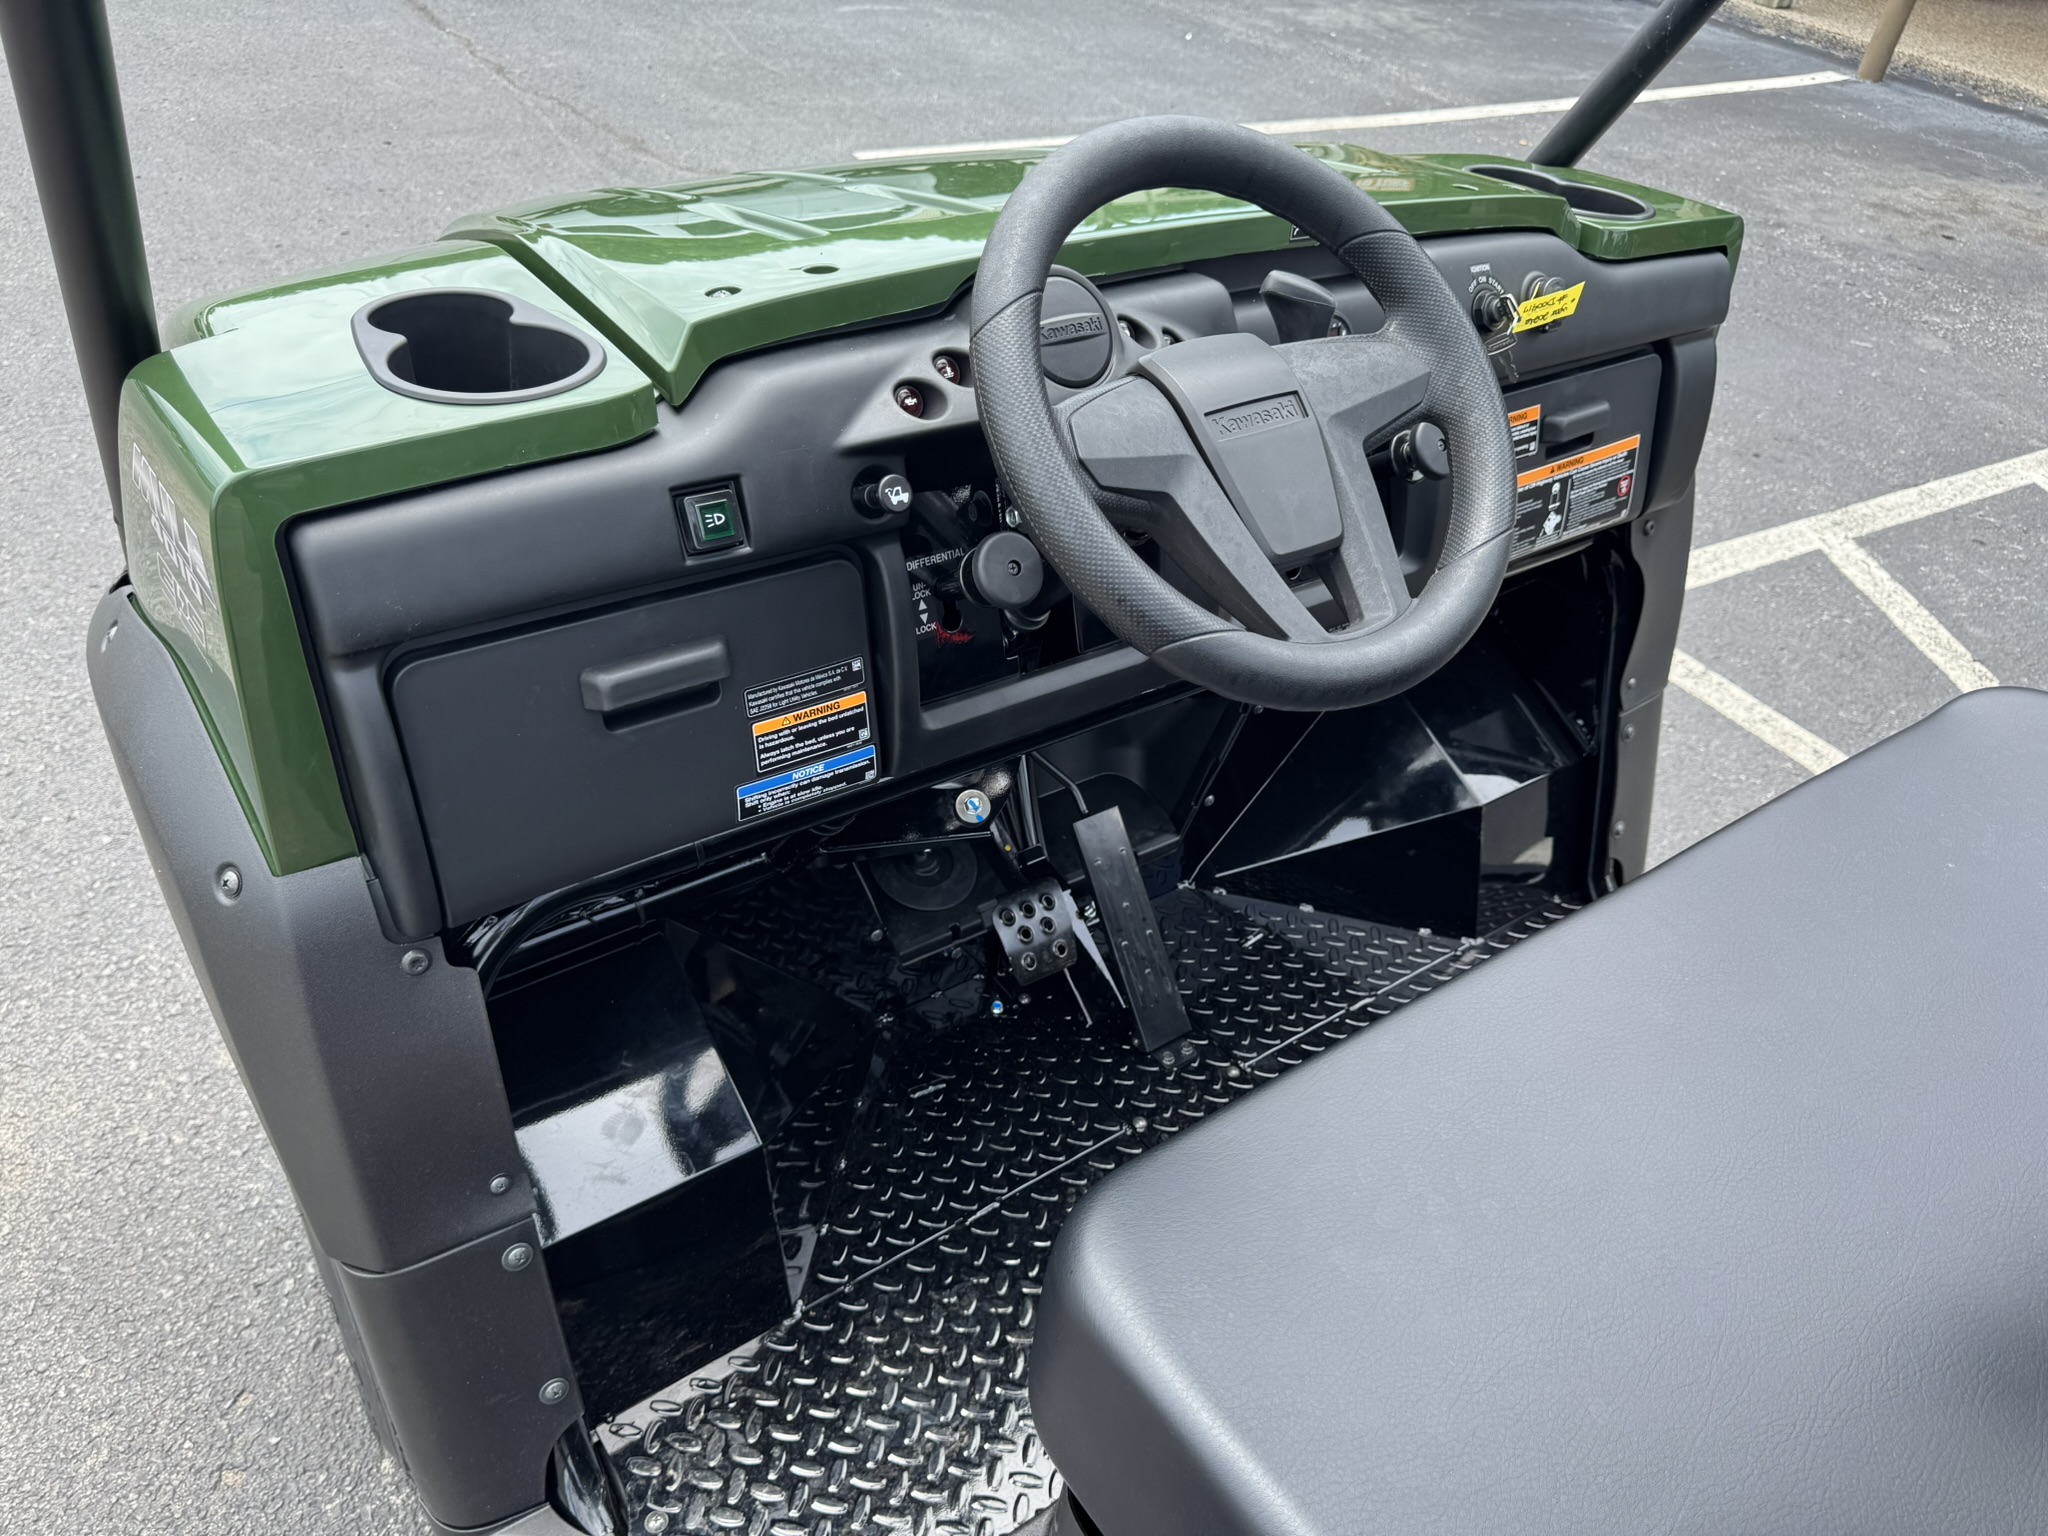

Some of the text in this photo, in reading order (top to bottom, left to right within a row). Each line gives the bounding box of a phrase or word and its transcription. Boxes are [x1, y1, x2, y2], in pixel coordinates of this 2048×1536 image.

[1470, 262, 1490, 273] IGNITION
[1468, 275, 1505, 295] OFF ON START
[1211, 399, 1299, 436] Kawasaki
[1556, 456, 1584, 472] WARNING
[906, 547, 964, 572] DIFFERENTIAL
[915, 621, 937, 635] LOCK
[747, 688, 773, 700] Manufactured
[778, 682, 795, 691] Kawasaki
[749, 697, 768, 708] Kawasaki
[785, 689, 793, 697] that
[750, 706, 759, 715] SAE
[779, 698, 789, 706] Light
[793, 701, 840, 722] WARNING
[758, 733, 778, 743] Driving
[778, 729, 791, 737] with
[798, 721, 818, 731] leaving
[828, 714, 839, 722] bed
[839, 705, 864, 718] unlatched
[760, 749, 780, 760] Always
[780, 744, 795, 753] latch
[817, 732, 836, 742] unless
[835, 729, 846, 737] you
[764, 735, 795, 748] hazardous.
[760, 742, 828, 767] performing maintenance.
[792, 763, 825, 781] NOTICE
[744, 760, 871, 804] Shifting incorrectly can damage transmission.
[744, 799, 760, 809] Shift
[759, 796, 773, 804] only
[762, 798, 784, 808] Engine
[796, 788, 811, 797] slow
